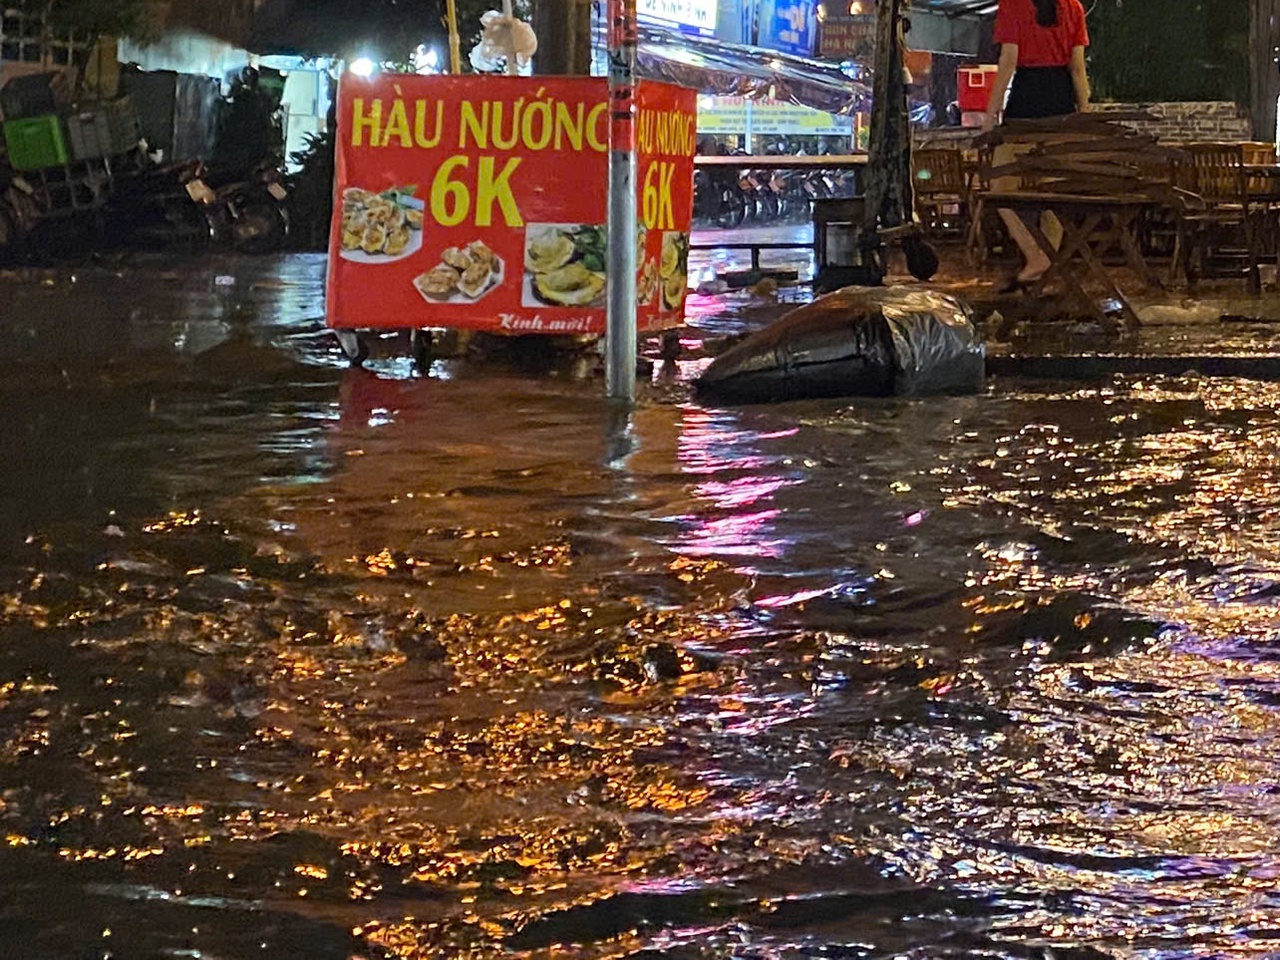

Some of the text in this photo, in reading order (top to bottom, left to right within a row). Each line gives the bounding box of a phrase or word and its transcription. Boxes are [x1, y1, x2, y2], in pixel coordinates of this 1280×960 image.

[352, 85, 444, 149] HÀU
[638, 94, 655, 155] ÀU
[430, 155, 525, 228] 6K
[642, 160, 675, 230] 6K
